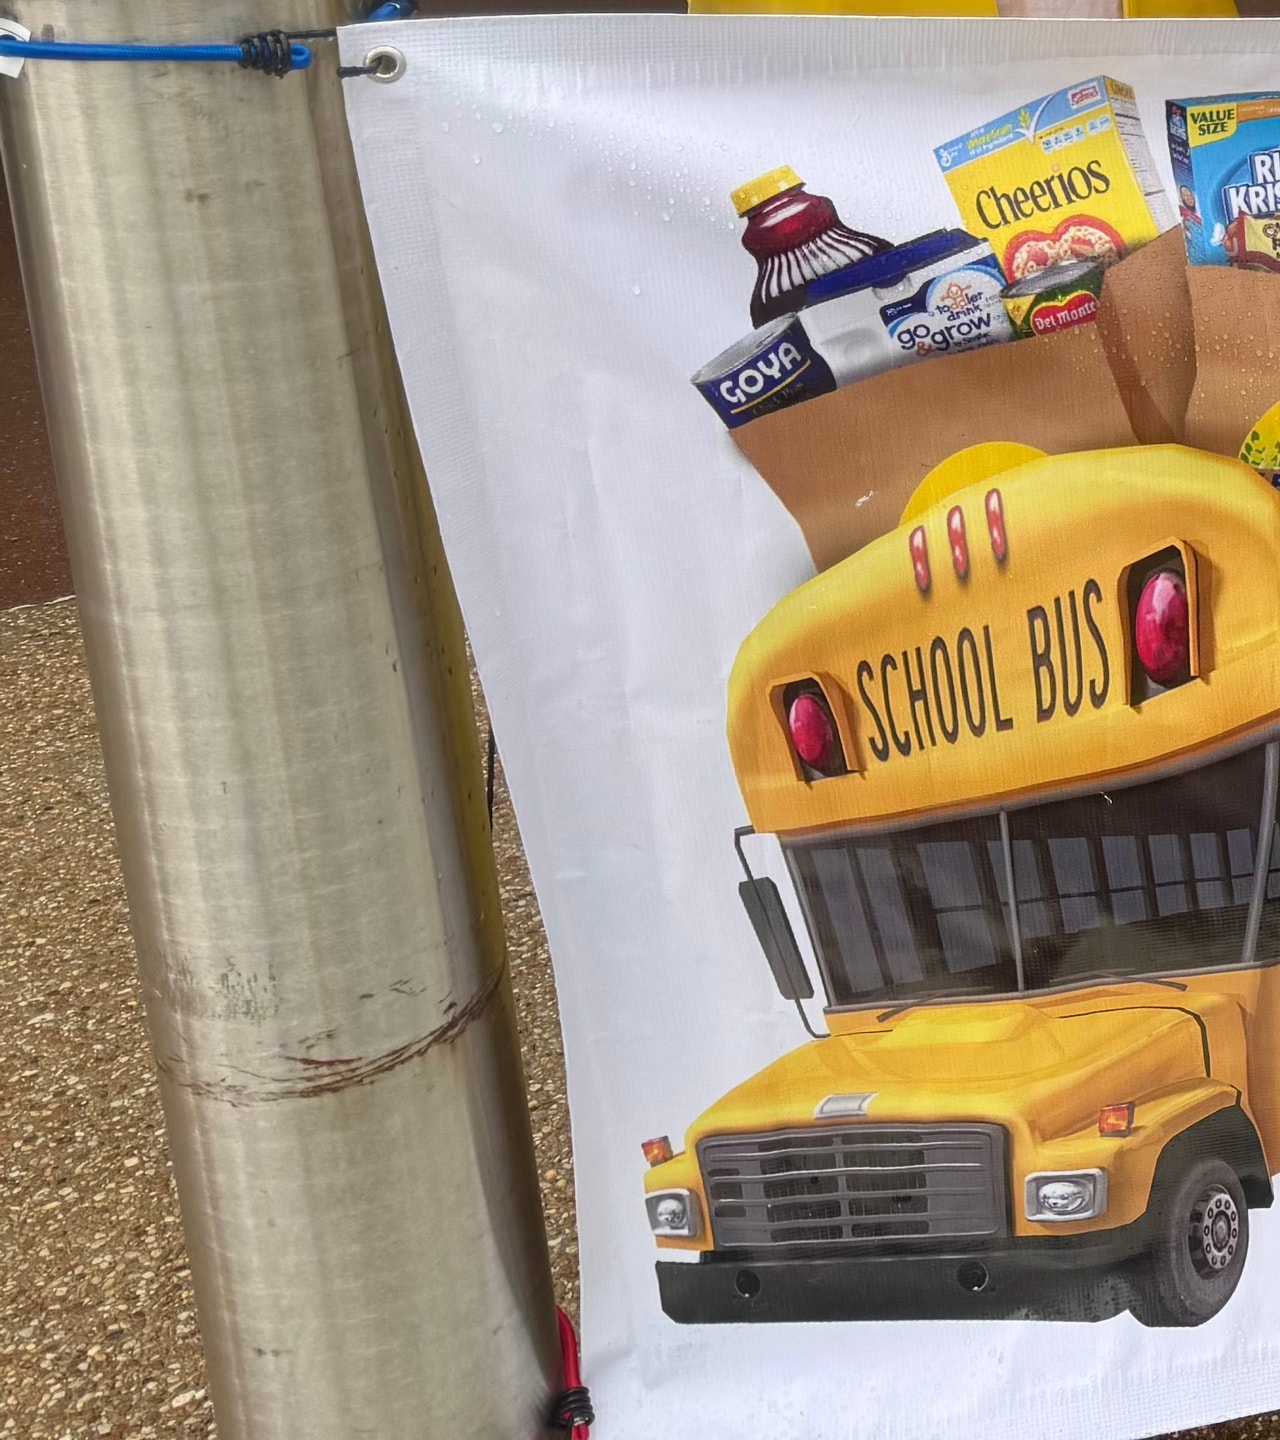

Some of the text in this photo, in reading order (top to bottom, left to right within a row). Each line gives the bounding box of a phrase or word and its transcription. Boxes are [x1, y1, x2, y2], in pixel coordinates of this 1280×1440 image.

[1190, 108, 1236, 124] VALUE
[1198, 121, 1229, 136] SIZE
[976, 160, 1111, 230] Cheerios
[935, 291, 984, 316] toddler
[947, 304, 983, 322] drink
[897, 324, 930, 350] go
[930, 313, 992, 351] grow
[1034, 316, 1056, 331] Del
[720, 342, 801, 403] GOYA
[856, 578, 1111, 763] SCHOOL BUS
